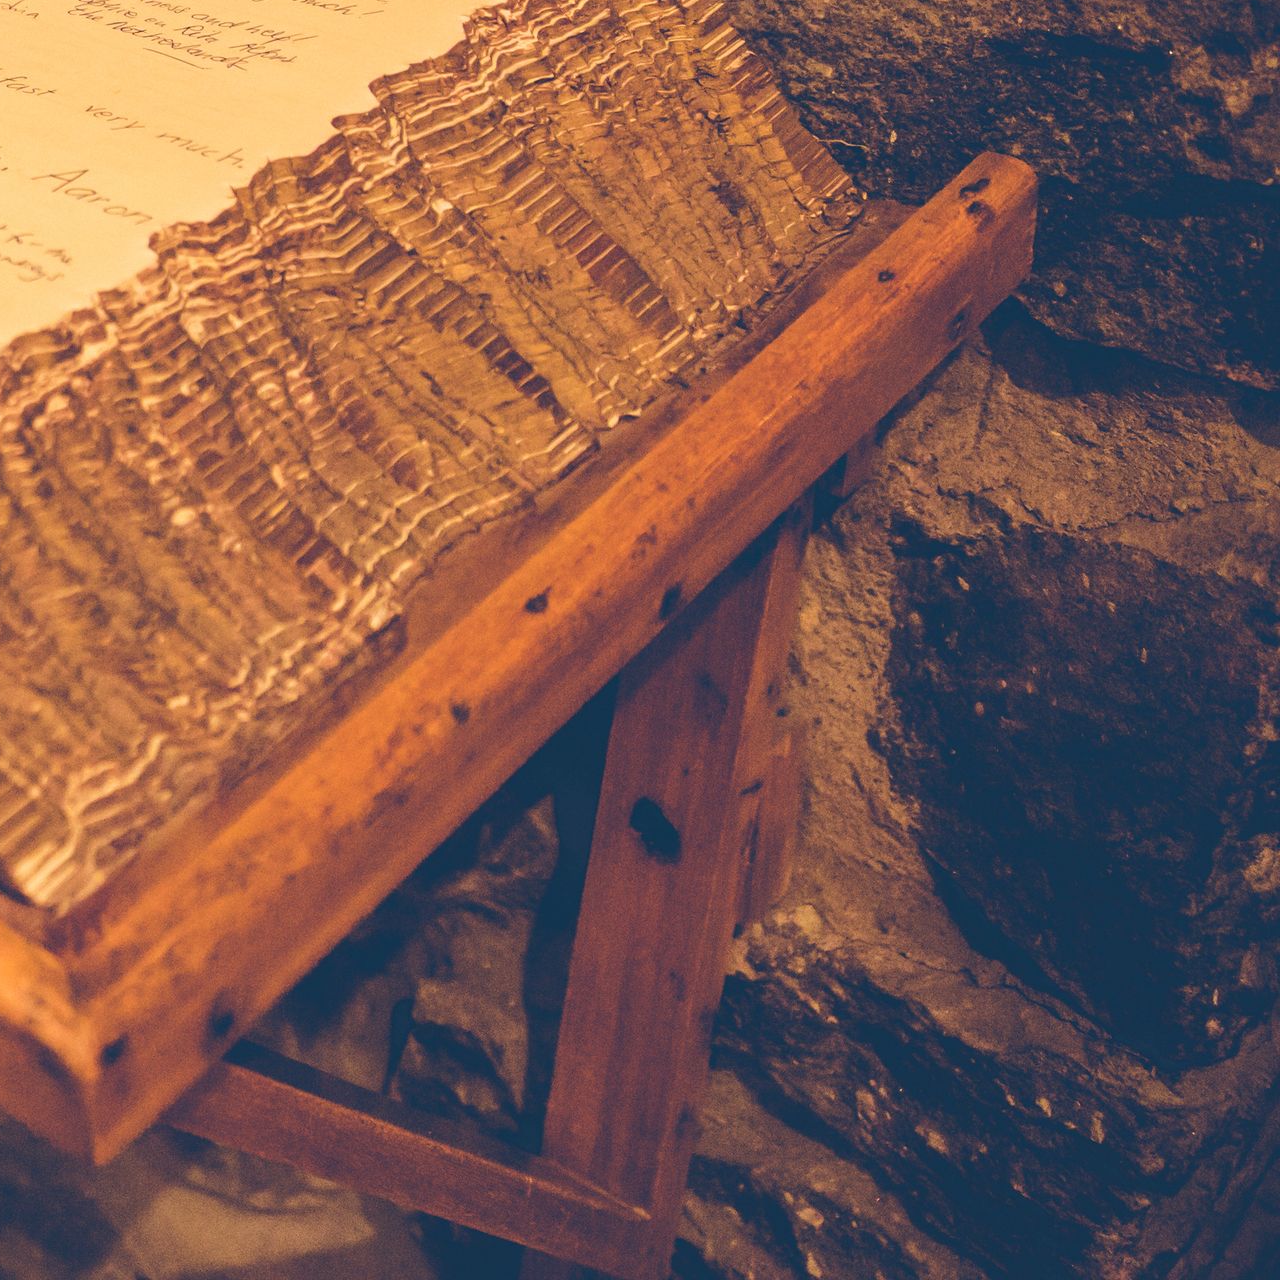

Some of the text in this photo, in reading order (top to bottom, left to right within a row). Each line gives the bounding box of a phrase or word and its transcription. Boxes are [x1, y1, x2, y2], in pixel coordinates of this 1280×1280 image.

[190, 13, 250, 29] and
[84, 104, 146, 131] very
[31, 169, 153, 226] Aaron
